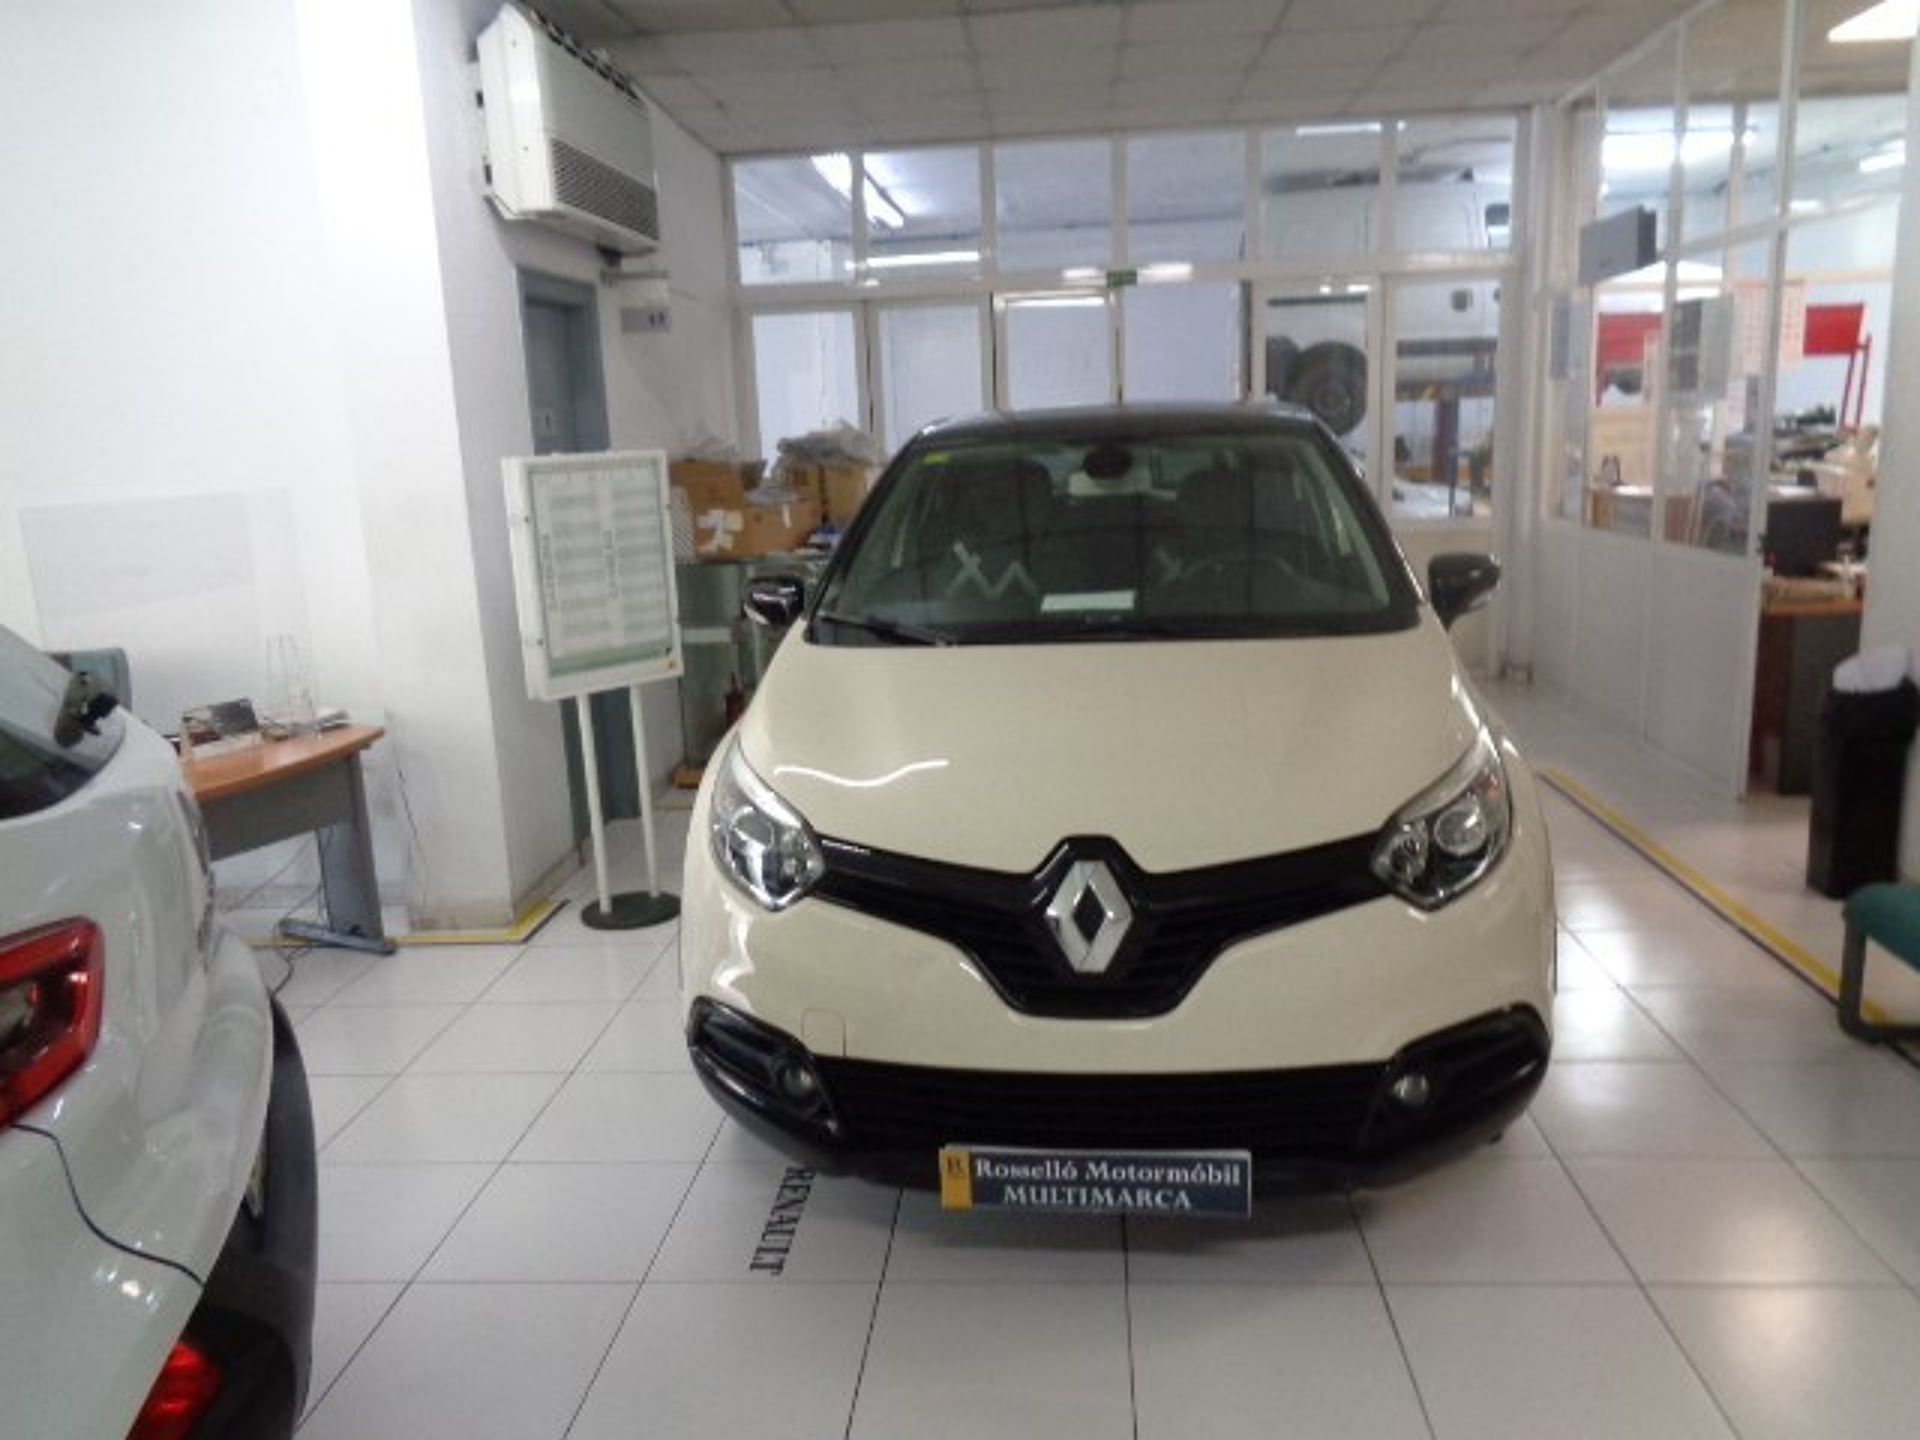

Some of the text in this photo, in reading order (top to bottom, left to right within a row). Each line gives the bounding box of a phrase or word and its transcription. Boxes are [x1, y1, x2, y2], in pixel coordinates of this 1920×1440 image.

[975, 1157, 1240, 1186] Rosselló Motormóbil
[1004, 1184, 1192, 1210] MULTIMARCA
[749, 1166, 817, 1276] RENAULT
